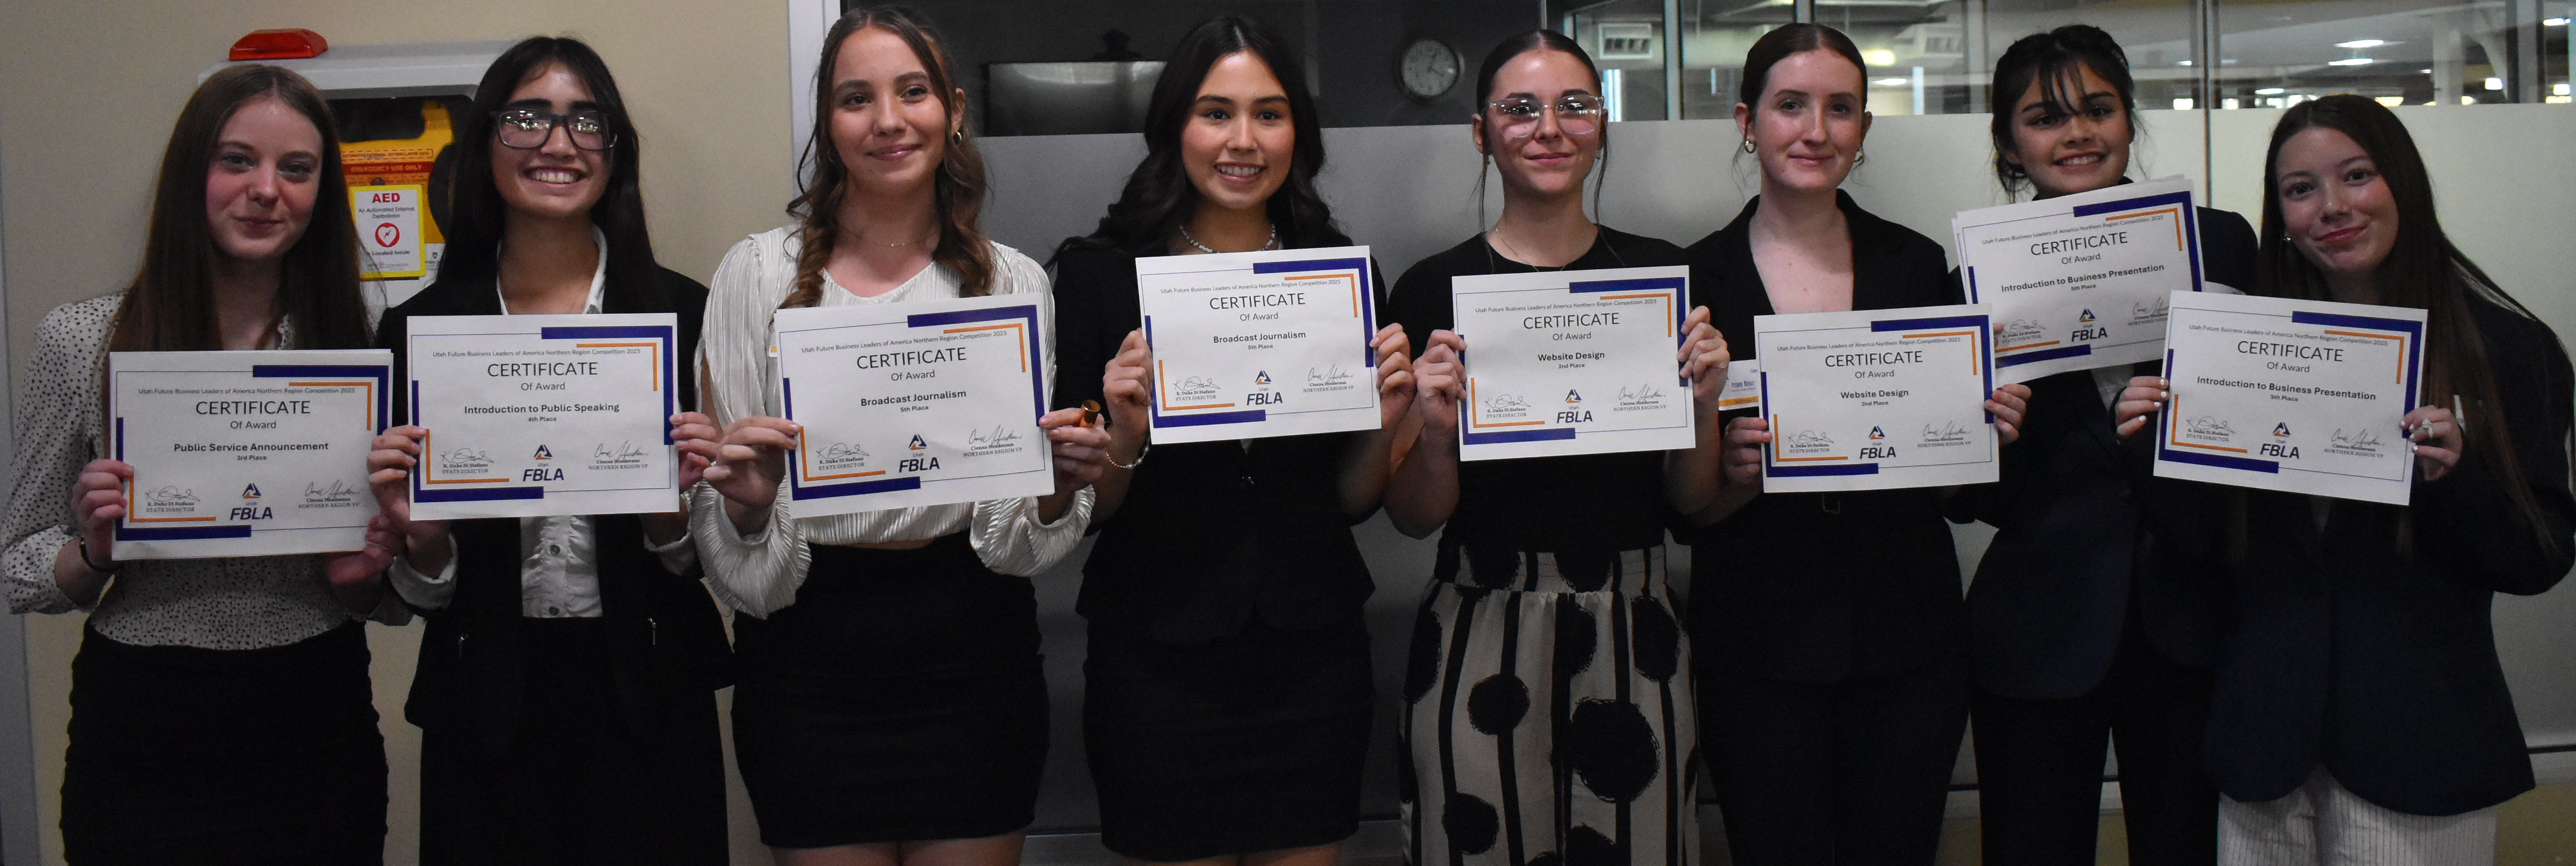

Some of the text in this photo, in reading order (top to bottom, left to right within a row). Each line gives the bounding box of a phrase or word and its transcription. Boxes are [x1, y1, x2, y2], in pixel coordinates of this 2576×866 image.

[372, 193, 400, 203] AED
[2030, 231, 2128, 255] CERTIFICATE
[2074, 252, 2101, 263] Award
[2001, 280, 2055, 292] Introduction
[2067, 273, 2107, 283] Business
[2108, 265, 2164, 278] Presentation
[1210, 293, 1306, 310] CERTIFICATE
[1252, 312, 1278, 320] Award
[1523, 312, 1620, 329] CERTIFICATE
[1213, 331, 1306, 343] Broadcast Journalism
[1565, 332, 1591, 340] Award
[2071, 327, 2108, 342] FBLA
[856, 346, 966, 369] CERTIFICATE
[1575, 351, 1605, 360] Design
[2237, 341, 2344, 362] CERTIFICATE
[1824, 350, 1923, 367] CERTIFICATE
[487, 361, 598, 377] CERTIFICATE
[1867, 369, 1894, 378] Award
[2280, 363, 2310, 372] Award
[891, 369, 935, 381] Of Award
[535, 381, 565, 390] Award
[2197, 376, 2255, 388] Introduction
[2269, 382, 2312, 394] Business
[2314, 387, 2376, 400] Presentation
[861, 390, 966, 406] Broadcast Journalism
[1246, 391, 1283, 406] FBLA
[1840, 389, 1909, 399] Website Design
[195, 400, 310, 415] CERTIFICATE
[464, 405, 526, 414] Introduction
[574, 403, 619, 413] Speaking
[1556, 410, 1593, 423] FBLA
[230, 420, 277, 429] Of Award
[174, 443, 206, 452] Public
[209, 443, 248, 451] Service
[1859, 446, 1896, 459] FBLA
[2259, 443, 2299, 459] FBLA
[899, 457, 940, 473] FBLA
[522, 468, 564, 482] FBLA
[229, 507, 273, 520] FBLA
